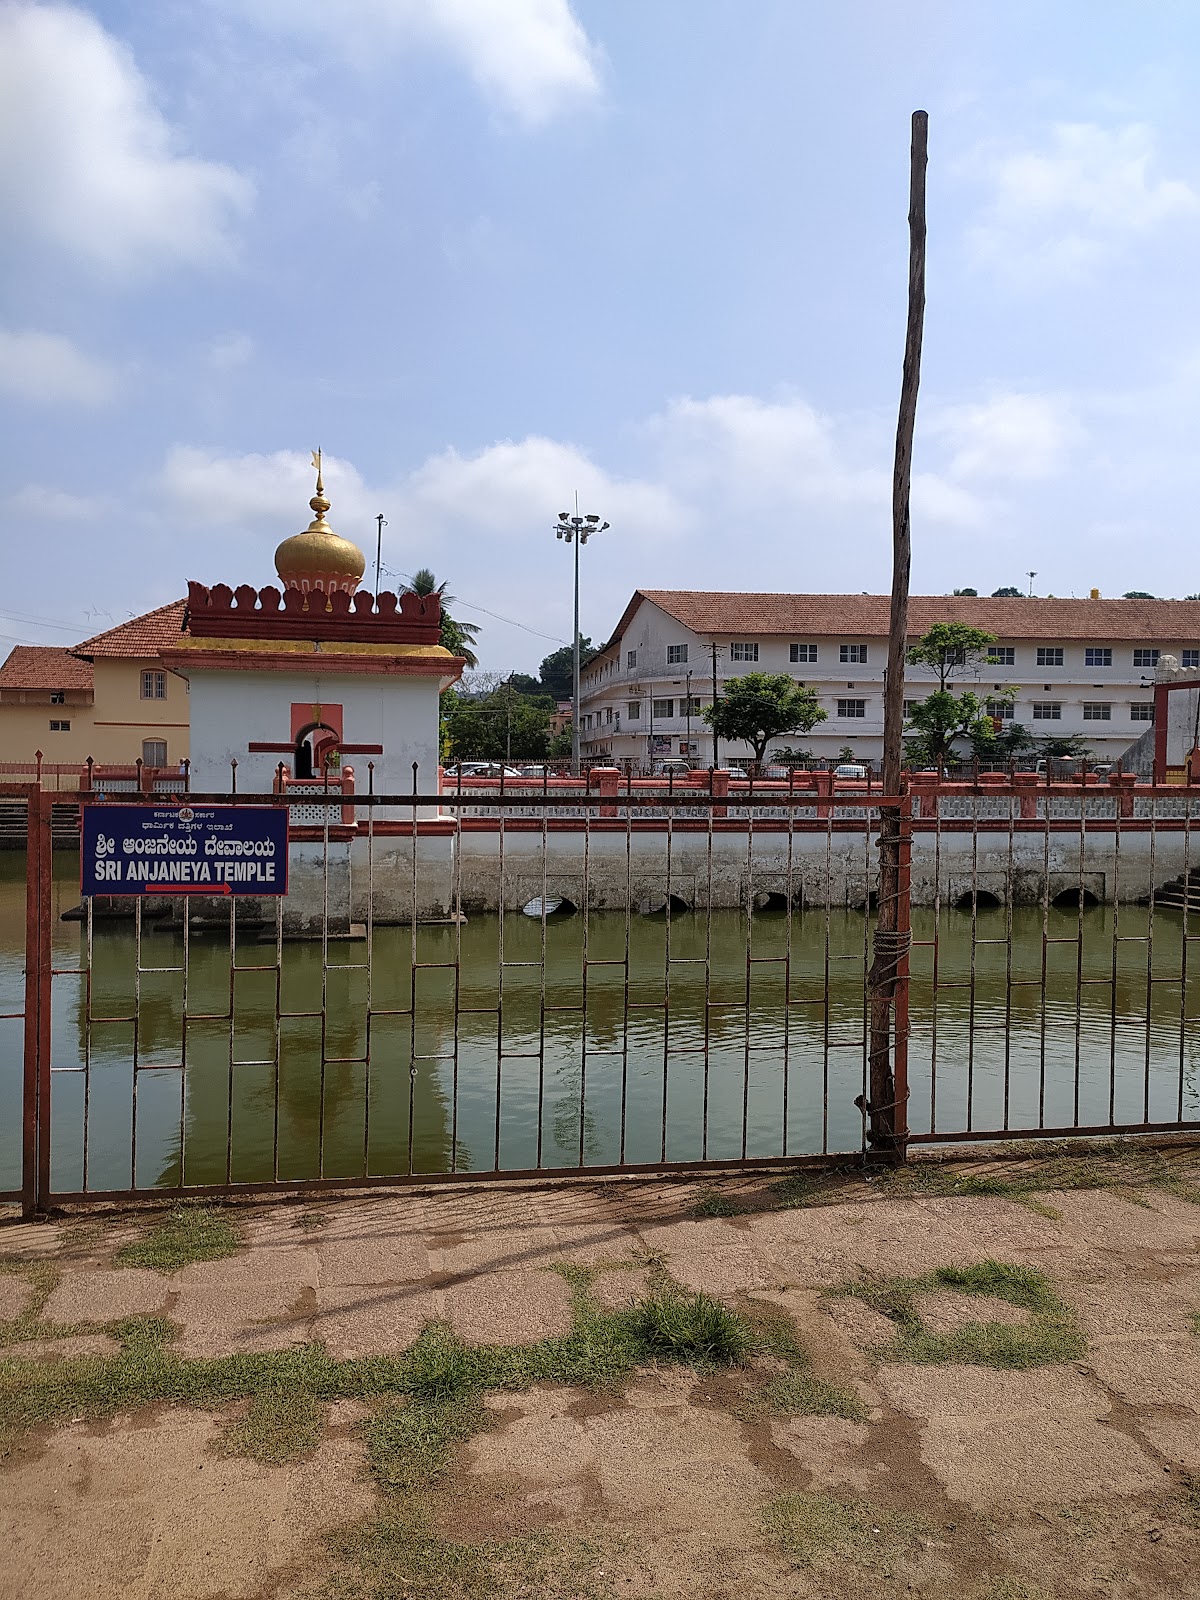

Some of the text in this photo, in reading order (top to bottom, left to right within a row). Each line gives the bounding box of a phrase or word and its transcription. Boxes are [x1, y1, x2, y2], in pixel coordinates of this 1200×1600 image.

[206, 823, 234, 831] ಇಲಾಖೆ
[94, 833, 276, 859] ಶ್ರೀ ಆಂಜನೇಯ ದೇವಾಲಯ
[94, 860, 276, 882] SRI ANJANEYA TEMPLE
